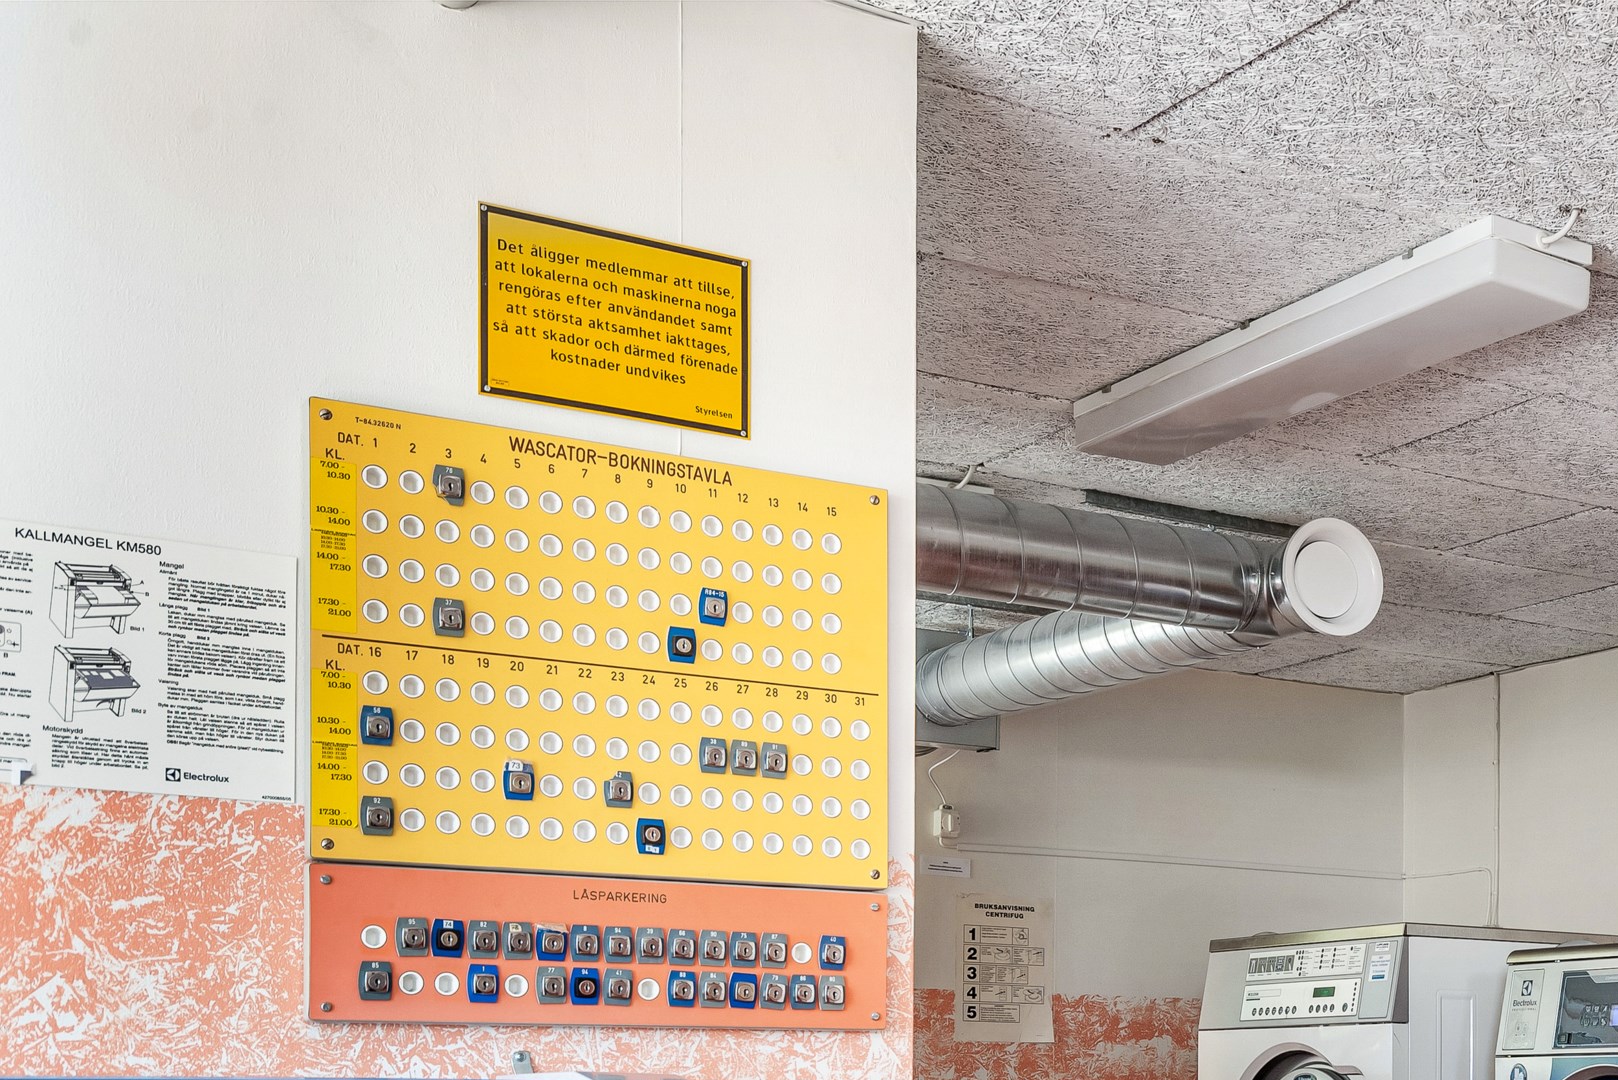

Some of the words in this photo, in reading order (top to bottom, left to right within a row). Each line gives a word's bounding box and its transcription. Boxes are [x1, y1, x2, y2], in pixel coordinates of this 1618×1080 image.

[497, 238, 524, 255] Det
[531, 244, 580, 266] åligger
[585, 258, 668, 284] medlemmar
[673, 276, 693, 290] att
[698, 281, 735, 300] tillse,
[495, 260, 516, 273] att
[521, 263, 588, 288] lokalerna
[593, 278, 618, 294] och
[623, 286, 701, 311] maskinerna
[705, 298, 737, 318] noga
[499, 280, 561, 302] rengöras
[566, 294, 602, 310] efter
[608, 302, 695, 328] användandet
[701, 321, 733, 337] samt
[506, 303, 527, 317] att
[532, 308, 582, 327] största
[588, 317, 661, 342] aktsamhet
[666, 333, 731, 357] iakttages,
[493, 319, 508, 333] så
[515, 324, 537, 338] att
[542, 328, 590, 347] skador
[594, 338, 619, 353] och
[624, 343, 675, 364] därmed
[680, 354, 738, 376] förenade
[550, 348, 621, 373] kostnader
[626, 364, 686, 385] undvikes
[695, 405, 733, 419] Styrelsen
[325, 447, 345, 461] KL.
[320, 460, 339, 470] 7.00
[509, 435, 733, 487] WASCATOR-BOKNINGSTAVLA
[327, 471, 351, 480] 10.30
[337, 431, 364, 447] DAT.
[372, 437, 378, 448] 1
[410, 443, 417, 454] 2
[445, 448, 452, 459] 3
[480, 453, 488, 464] 4
[514, 458, 521, 469] 5
[548, 463, 555, 474] 6
[581, 468, 588, 478] 7
[615, 473, 621, 484] 8
[647, 478, 653, 488] 9
[675, 483, 687, 494] 10
[708, 488, 717, 498] 11
[737, 493, 749, 503] 12
[768, 497, 779, 508] 13
[797, 502, 808, 513] 14
[826, 506, 837, 517] 15
[316, 505, 339, 515] 10.30
[328, 516, 351, 526] 14.00
[14, 527, 114, 550] KALLMANGEL
[116, 541, 162, 556] KM580
[316, 551, 339, 561] 14.00
[159, 560, 185, 570] Mangel
[329, 563, 352, 572] 17.30
[317, 597, 339, 606] 17.30
[327, 608, 351, 618] 21.00
[325, 659, 346, 671] KL.
[320, 670, 339, 679] 7.00
[337, 643, 364, 657] DAT.
[368, 646, 382, 658] 16
[405, 650, 419, 661] 17
[441, 654, 455, 665] 18
[477, 658, 490, 668] 19
[509, 661, 524, 672] 20
[546, 664, 558, 675] 21
[578, 668, 592, 679] 22
[610, 671, 625, 682] 23
[642, 674, 656, 685] 24
[674, 678, 687, 688] 25
[705, 681, 719, 692] 26
[736, 684, 749, 695] 27
[765, 687, 778, 698] 28
[796, 690, 809, 701] 29
[825, 693, 837, 704] 30
[854, 696, 866, 707] 31
[327, 680, 352, 690] 10.30
[316, 716, 340, 725] 10.30
[42, 725, 84, 734] Motorskydd
[328, 727, 352, 736] 14.00
[317, 762, 340, 770] 14.00
[511, 761, 520, 769] 73
[183, 771, 230, 783] Electrolux
[331, 773, 353, 781] 17.30
[318, 808, 342, 816] 17.30
[328, 818, 353, 827] 21.00
[572, 888, 667, 904] LÅSPARKERING
[974, 903, 1035, 912] BRUKSANVISNING
[985, 911, 1024, 919] CENTRIFUG
[968, 928, 976, 941] 1
[967, 947, 977, 960] 2
[967, 967, 977, 980] 3
[967, 986, 977, 999] 4
[967, 1006, 977, 1019] 5
